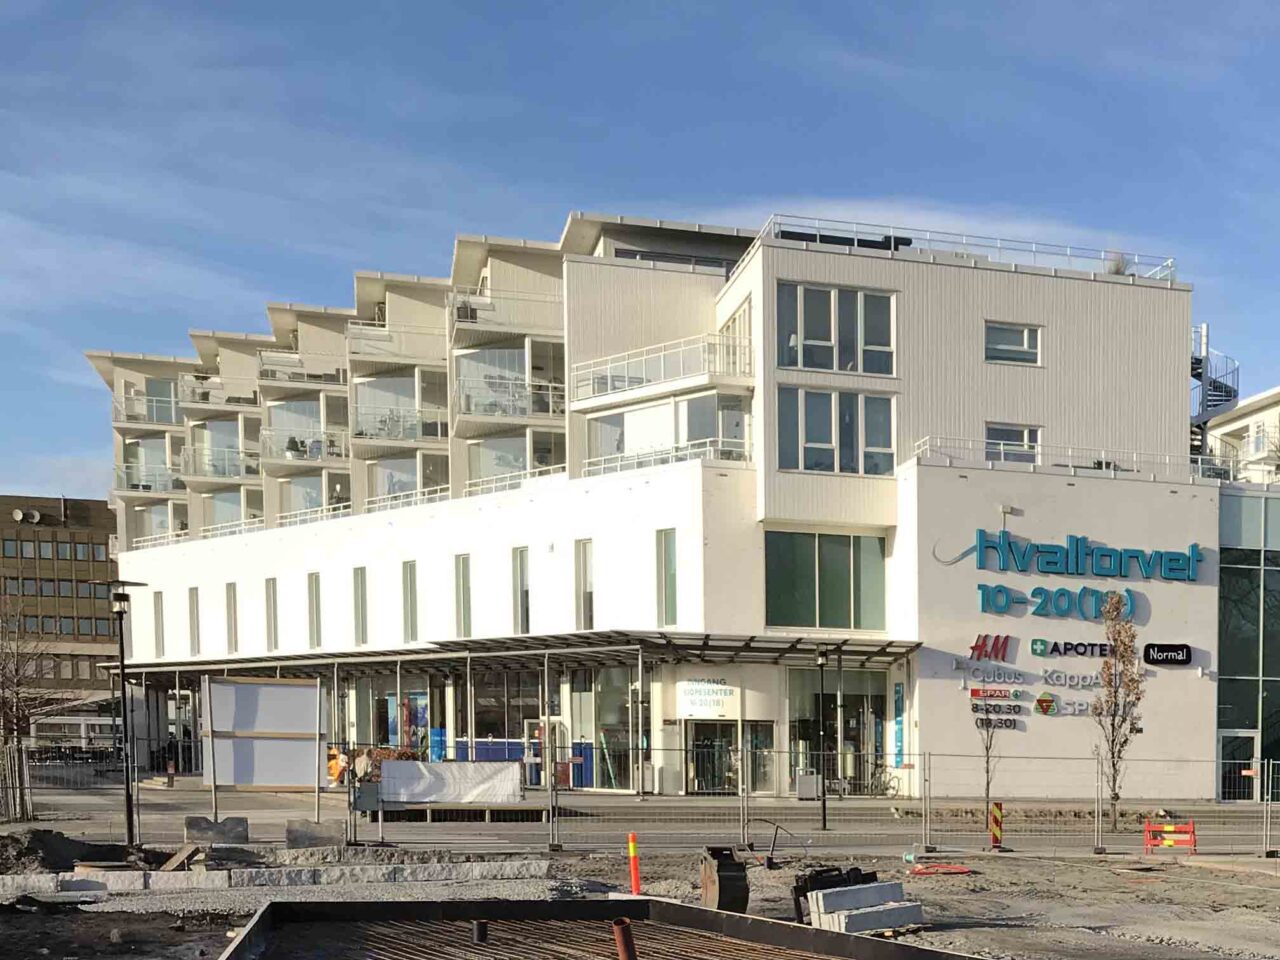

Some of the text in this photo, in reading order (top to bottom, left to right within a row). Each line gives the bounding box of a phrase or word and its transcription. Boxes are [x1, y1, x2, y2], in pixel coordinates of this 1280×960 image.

[1149, 647, 1187, 660] Normal
[971, 667, 1024, 684] Cubus
[1041, 667, 1116, 688] KappA
